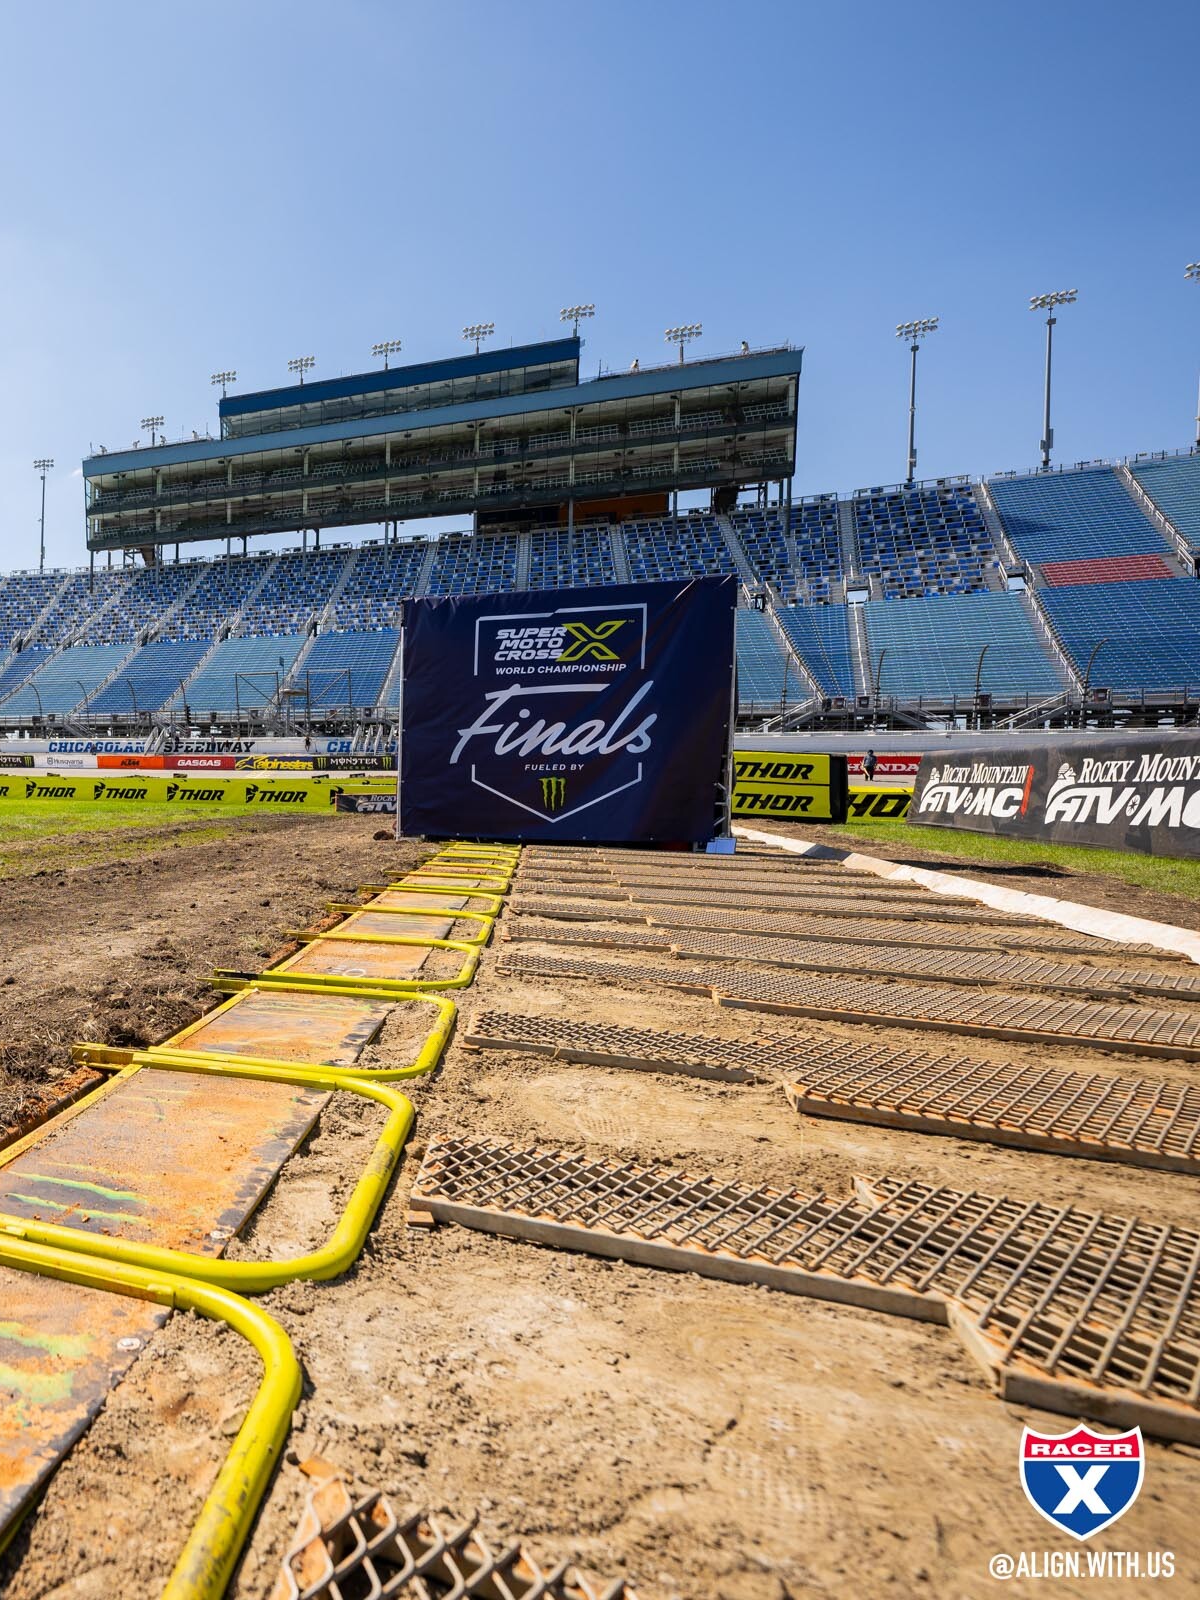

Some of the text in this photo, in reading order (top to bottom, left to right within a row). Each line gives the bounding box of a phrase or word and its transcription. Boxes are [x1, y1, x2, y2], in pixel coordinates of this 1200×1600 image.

[496, 627, 567, 640] SUPER
[500, 638, 564, 650] MOTO
[494, 648, 564, 661] CROSS
[495, 663, 627, 675] WORLD CHAMPIONSHIP
[449, 680, 658, 764] Finals
[48, 741, 154, 753] CHICAGOLAN
[177, 759, 221, 767] GASGAS
[256, 758, 314, 770] alpinestars
[330, 757, 379, 766] MONSTER
[570, 763, 585, 771] BY
[848, 763, 920, 772] HNDA
[735, 761, 815, 780] THOR
[940, 763, 1030, 784] ROCKY MOUNTAIN
[1077, 758, 1136, 784] ROCKY
[37, 786, 76, 798] THOR
[106, 788, 148, 799] THOR
[179, 789, 225, 801] THOR
[259, 790, 307, 803] THOR
[734, 793, 814, 812] THOR
